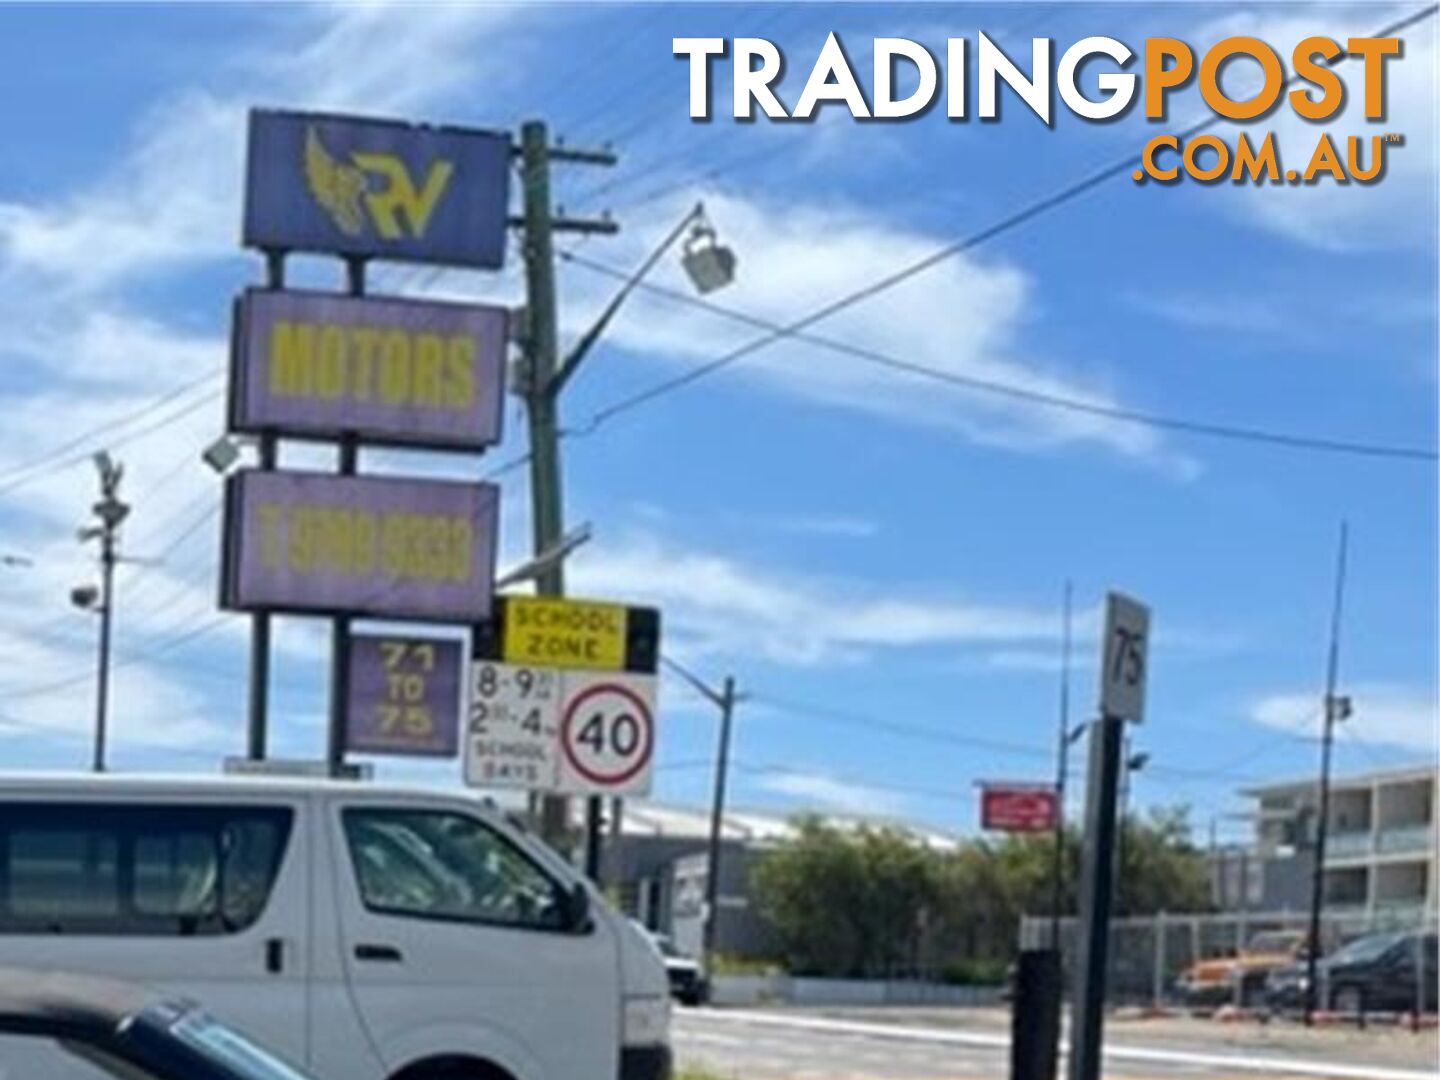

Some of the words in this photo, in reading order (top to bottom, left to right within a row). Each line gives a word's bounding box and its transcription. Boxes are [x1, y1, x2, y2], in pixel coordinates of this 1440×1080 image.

[271, 321, 477, 411] MOTORS
[514, 605, 619, 634] SCHOOL
[379, 642, 433, 672] 71
[527, 632, 602, 661] ZONE
[1114, 626, 1144, 687] 75
[386, 674, 424, 702] TO
[377, 704, 433, 736] 75
[576, 710, 640, 758] 40
[474, 739, 548, 763] SCHOOL
